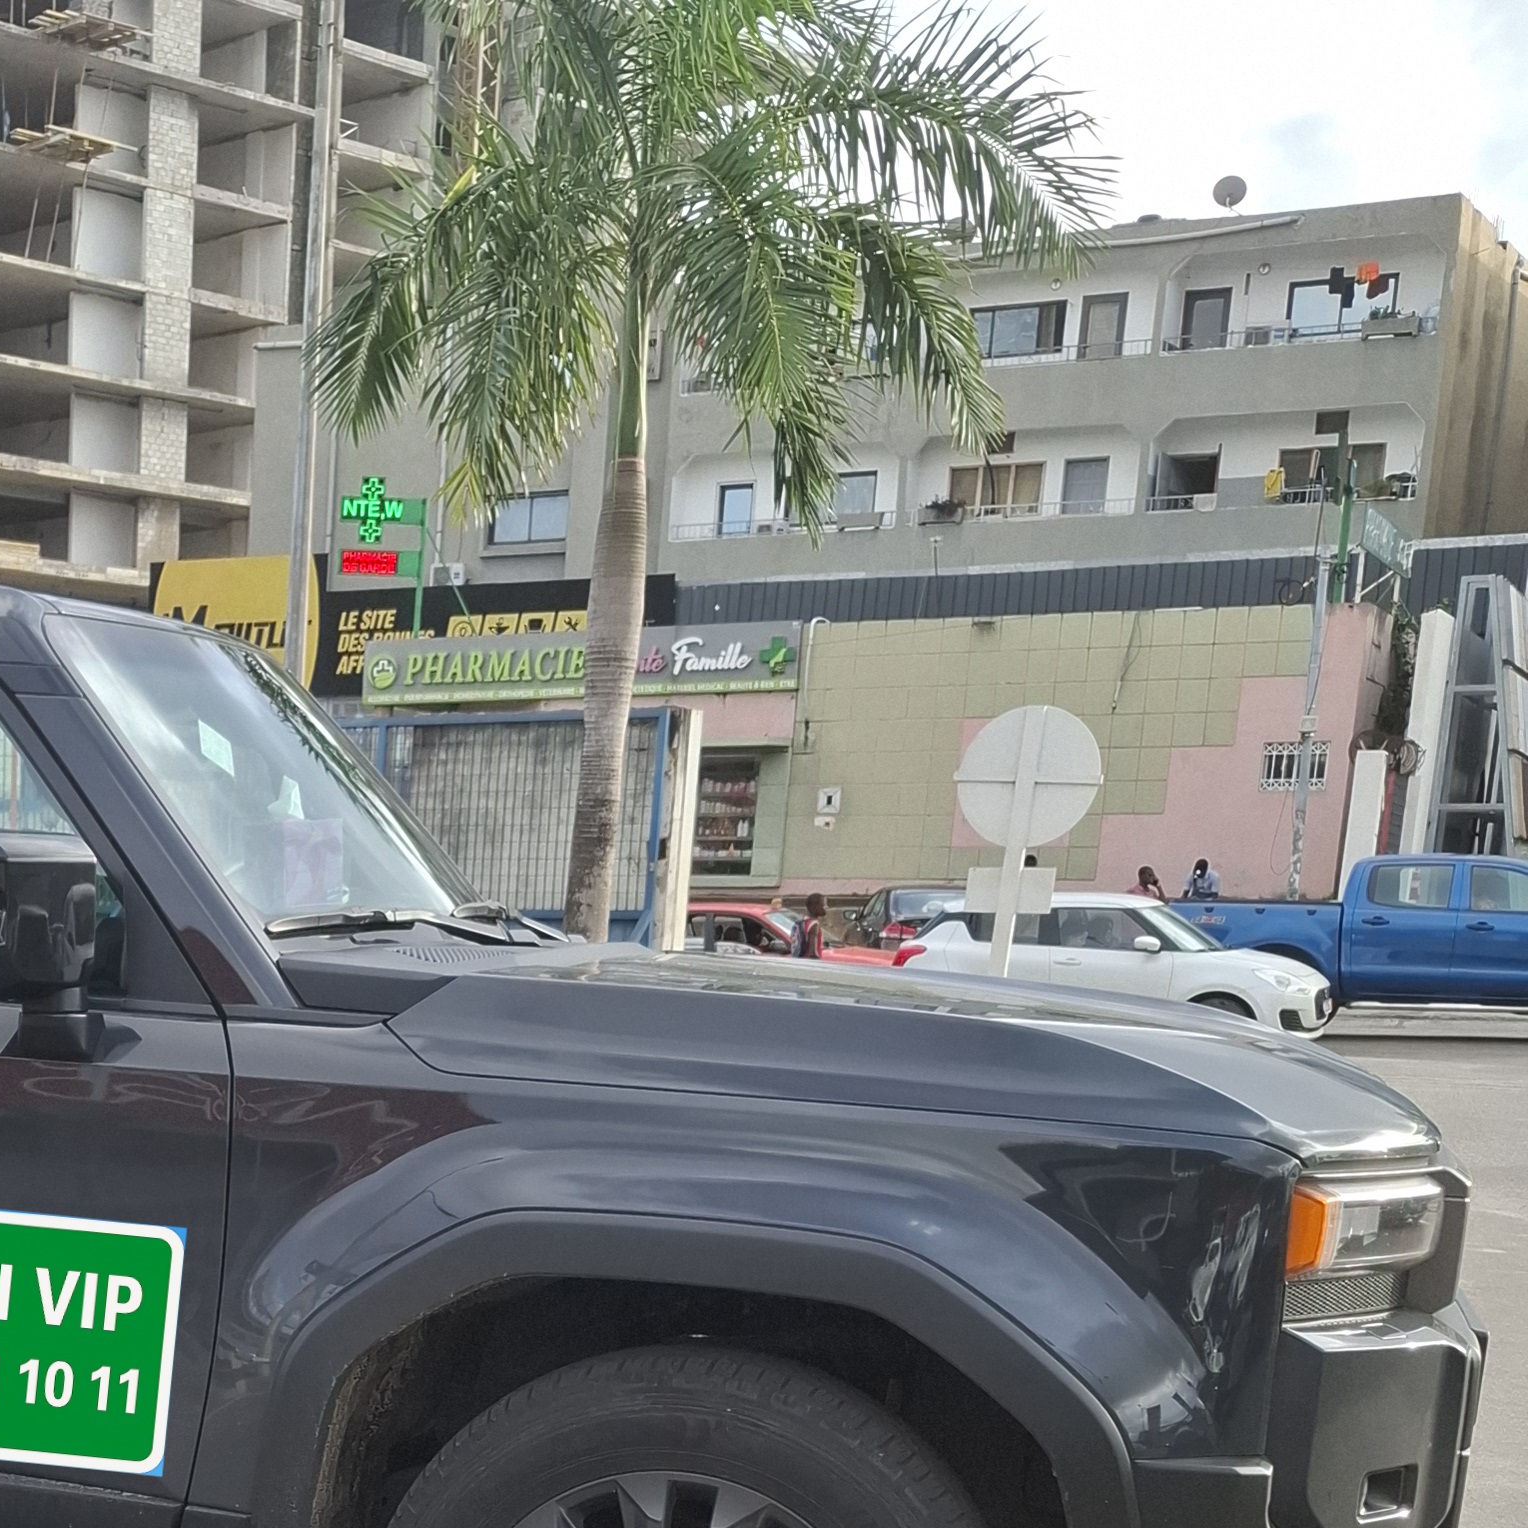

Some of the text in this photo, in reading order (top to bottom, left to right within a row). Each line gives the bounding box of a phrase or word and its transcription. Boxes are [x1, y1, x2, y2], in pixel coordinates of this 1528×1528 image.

[339, 609, 397, 631] LE SITE
[337, 632, 365, 653] DES
[403, 646, 587, 686] PHARMACIE
[672, 636, 753, 677] Famille
